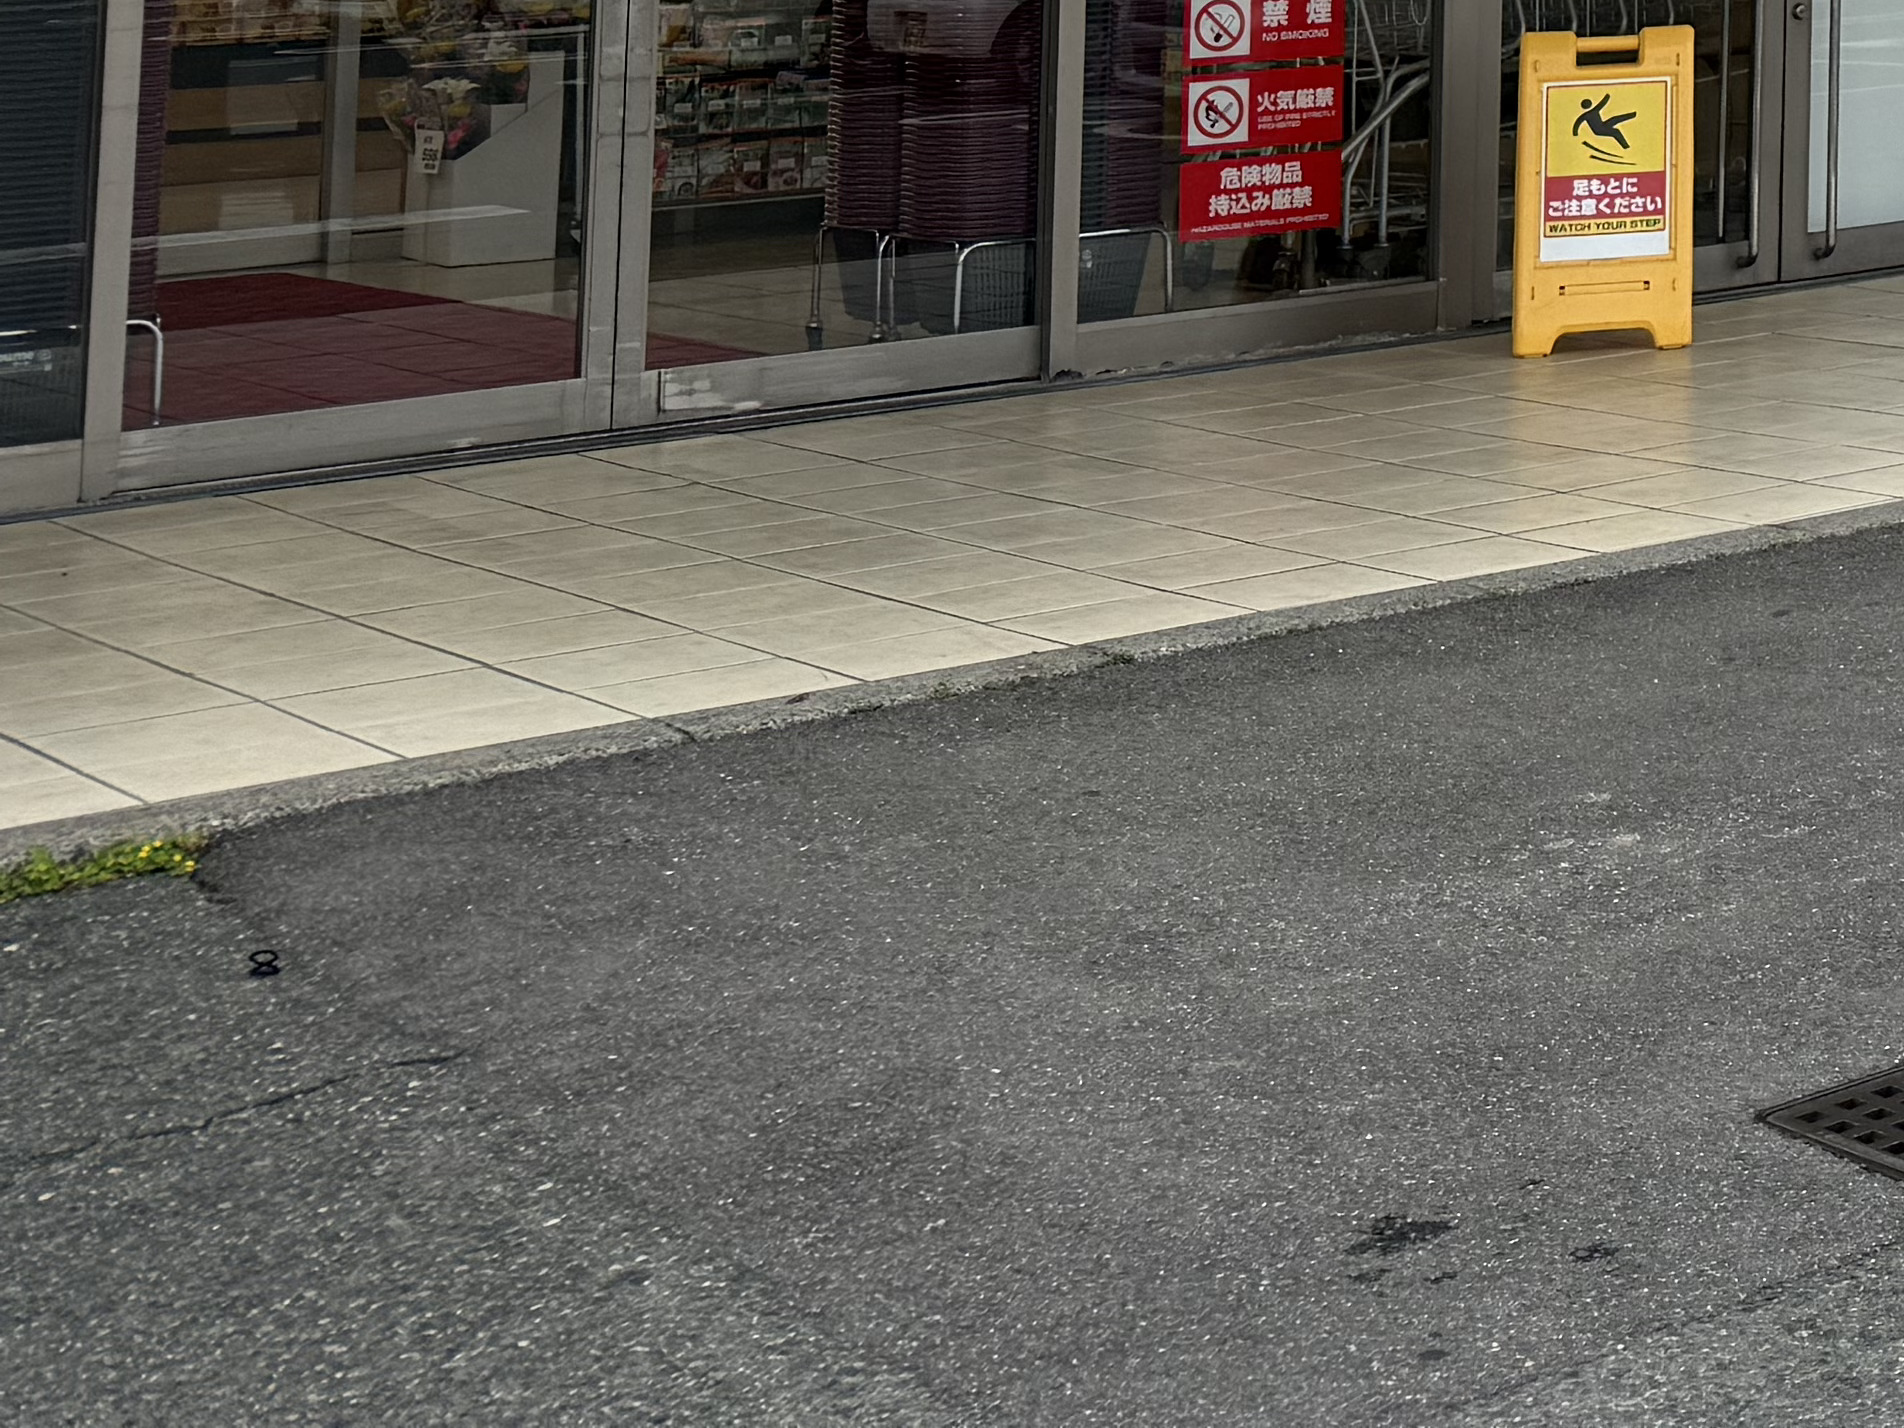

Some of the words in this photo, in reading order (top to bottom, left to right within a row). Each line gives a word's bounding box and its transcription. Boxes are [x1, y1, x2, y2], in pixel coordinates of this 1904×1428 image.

[1262, 33, 1278, 42] NO
[1257, 87, 1334, 112] 火気厳禁
[1220, 161, 1303, 190] 危険物品
[1573, 177, 1638, 196] 足もとに
[1209, 185, 1312, 218] 持込み厳禁
[1548, 196, 1663, 217] ご注意ください
[1548, 222, 1591, 233] WATCH
[1593, 219, 1627, 230] YOUR
[1629, 218, 1661, 228] STEP
